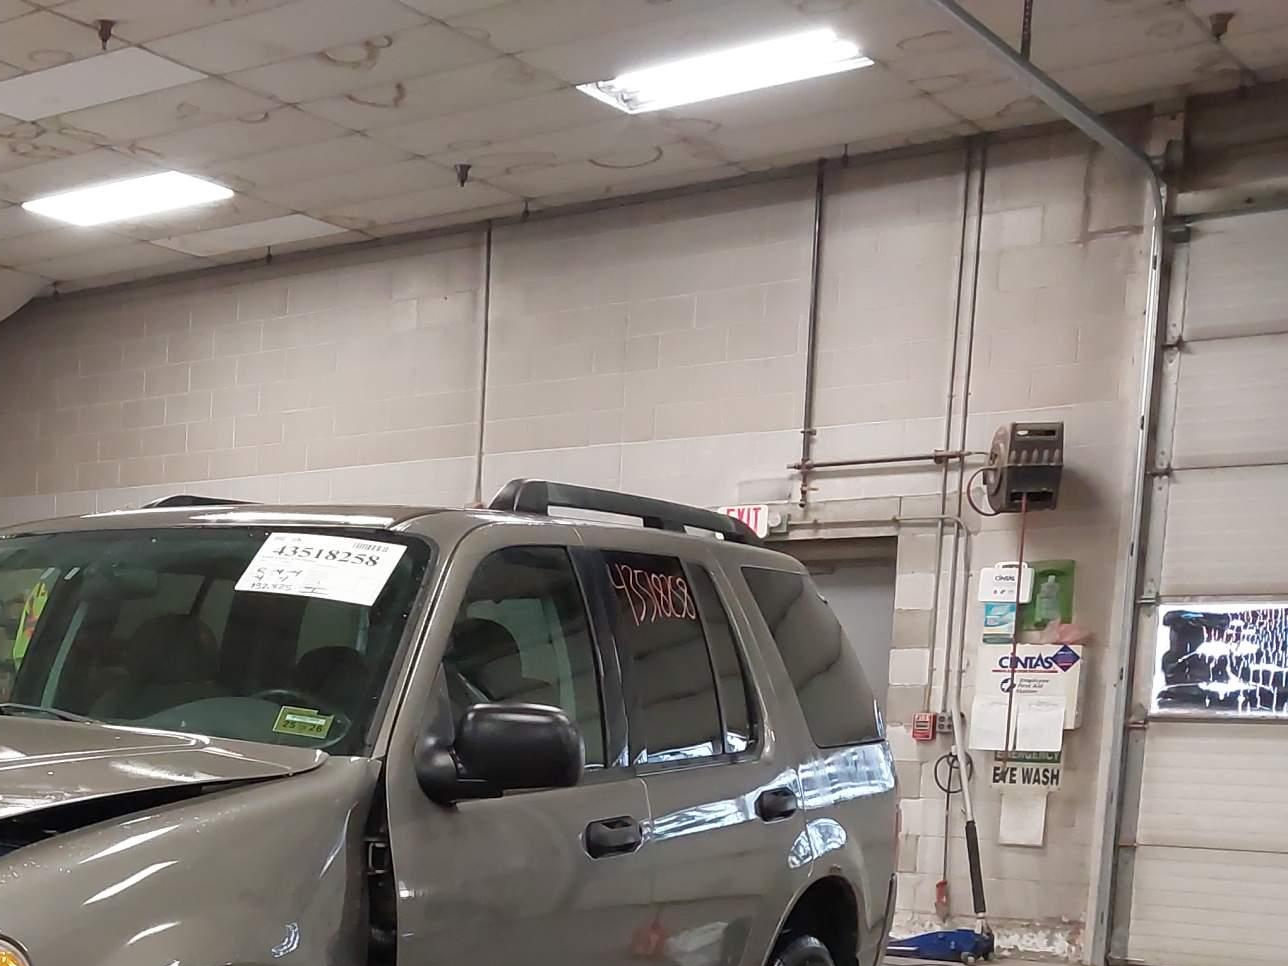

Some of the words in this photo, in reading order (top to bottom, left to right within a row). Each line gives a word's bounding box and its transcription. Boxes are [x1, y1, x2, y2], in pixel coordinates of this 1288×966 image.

[272, 545, 381, 567] 43518258
[998, 651, 1054, 670] CINTAS
[992, 766, 1018, 784] EYE
[1021, 767, 1060, 786] WASH
